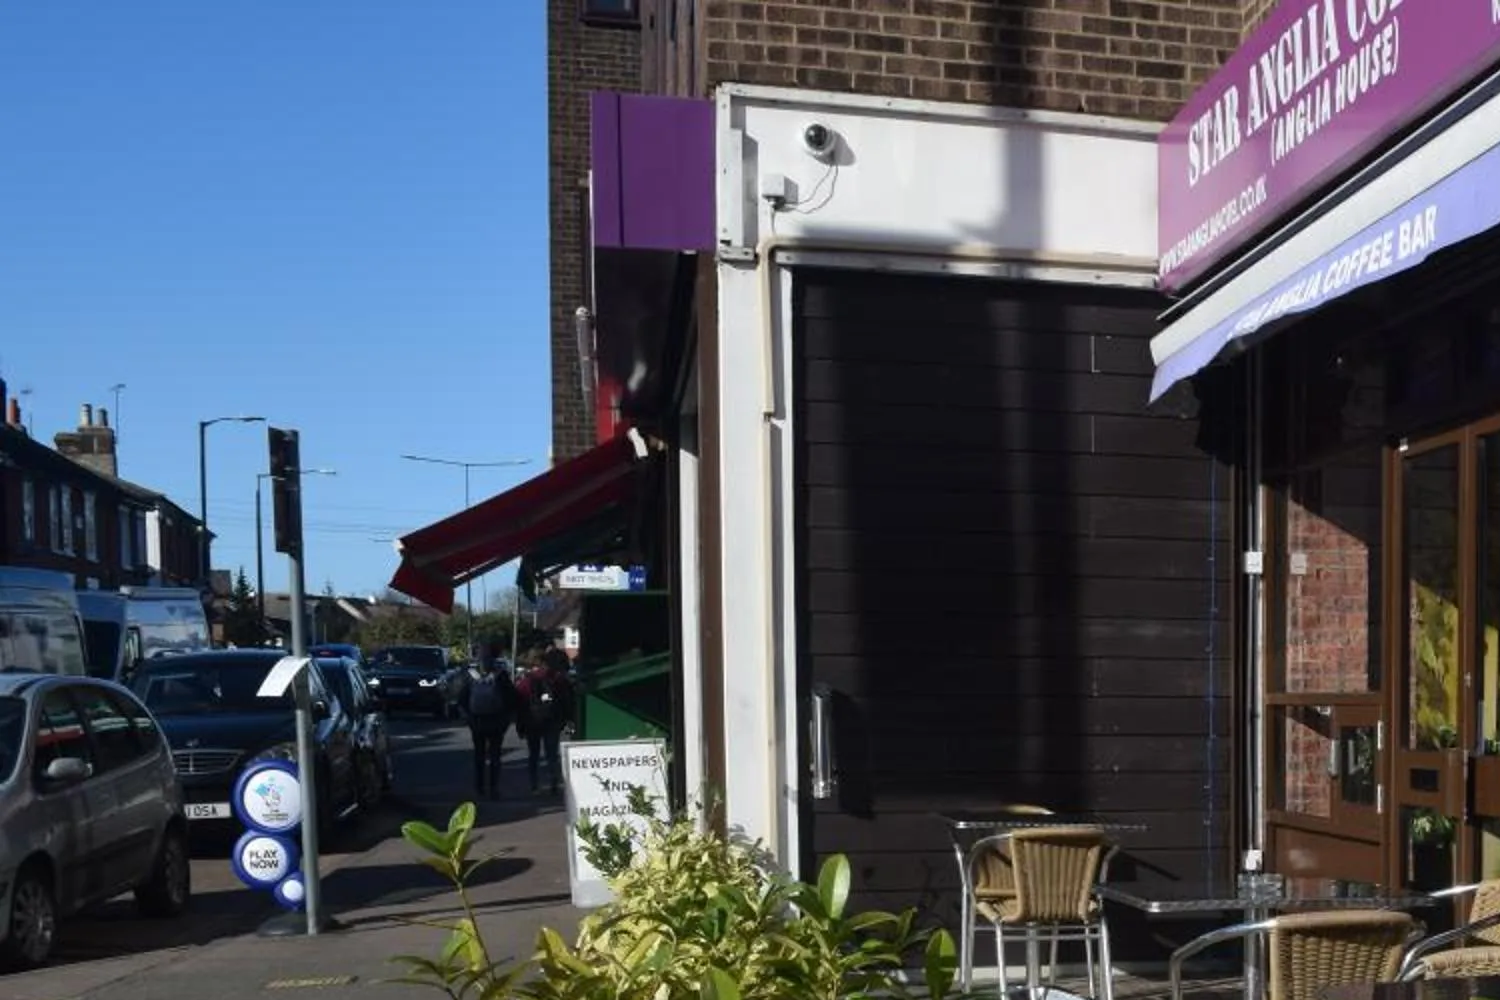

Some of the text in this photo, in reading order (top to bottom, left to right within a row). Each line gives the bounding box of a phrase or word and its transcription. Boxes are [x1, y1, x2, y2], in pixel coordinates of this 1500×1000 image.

[1188, 0, 1341, 187] STAR ANGLIA
[1270, 78, 1331, 167] (ANGLIA
[1335, 15, 1399, 112] HOUSE)
[1323, 231, 1394, 293] COFFEE
[1397, 205, 1437, 260] BAR
[571, 755, 657, 769] NEWSPAPERS
[250, 849, 278, 859] PLAY
[250, 860, 279, 869] NOW
